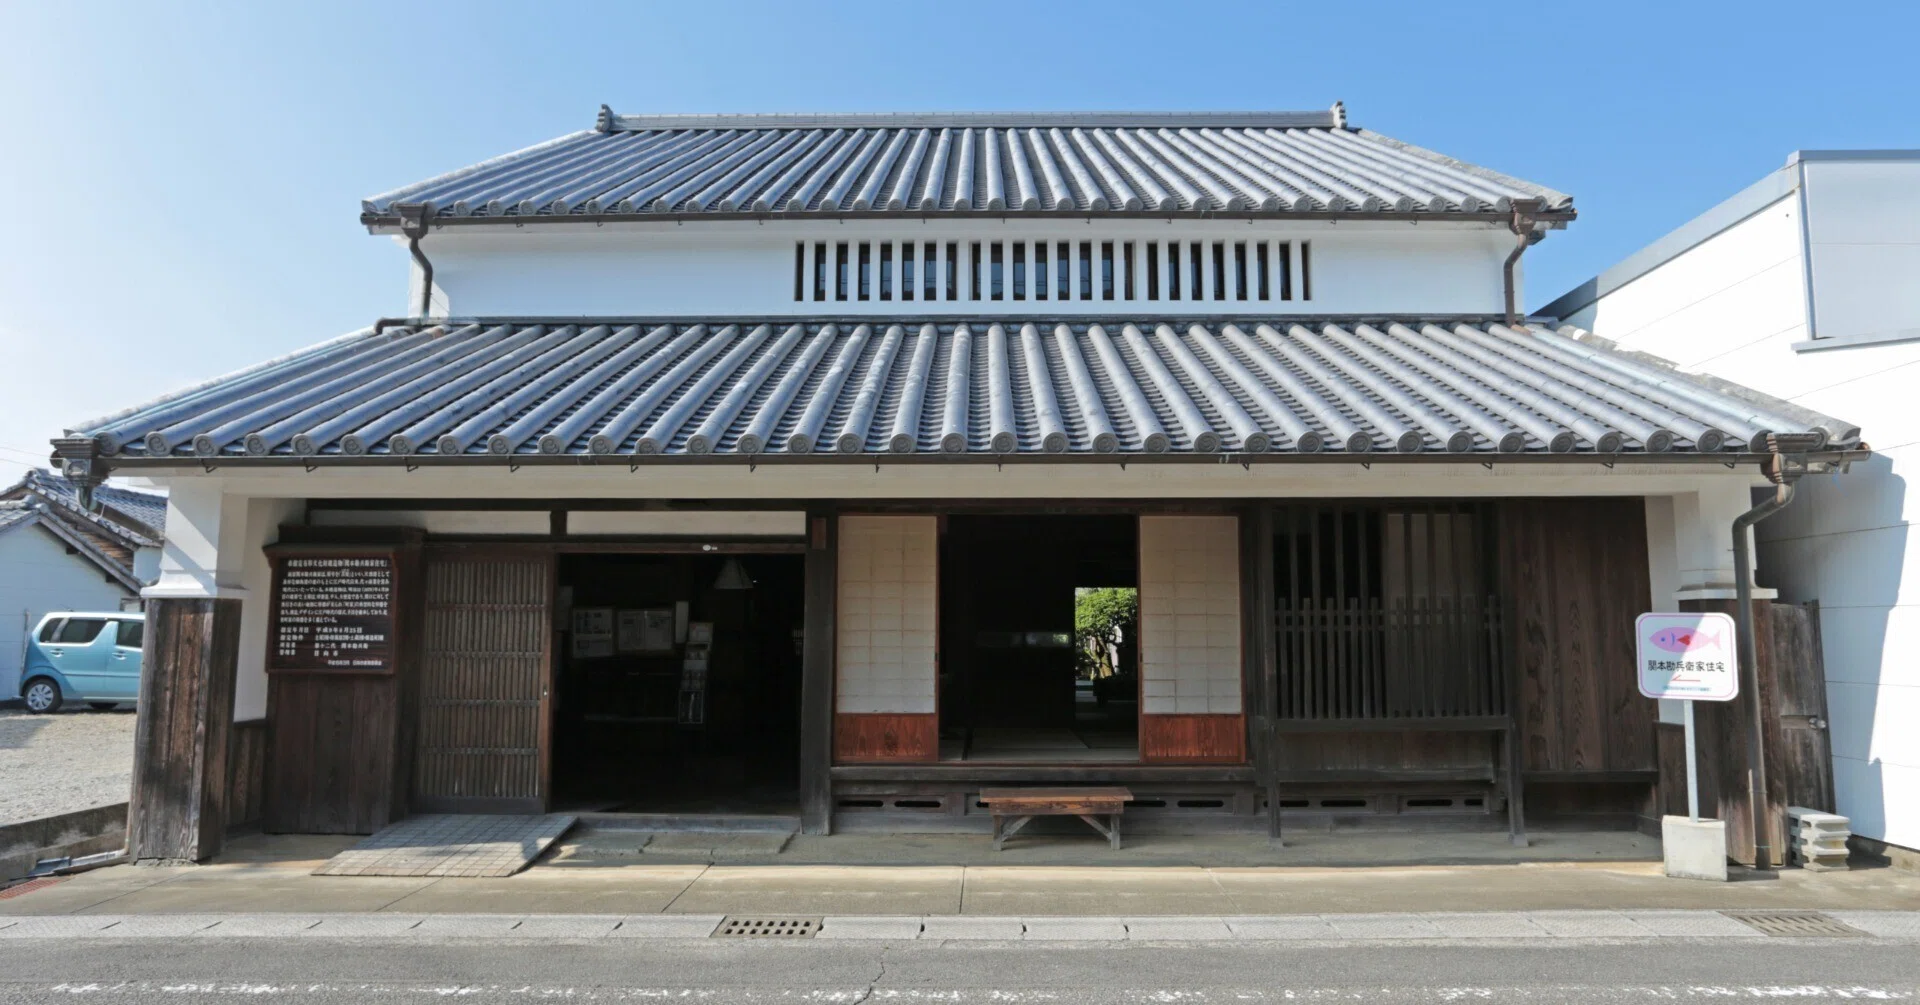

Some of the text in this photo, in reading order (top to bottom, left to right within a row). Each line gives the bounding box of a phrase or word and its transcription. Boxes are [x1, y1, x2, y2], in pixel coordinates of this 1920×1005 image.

[1647, 660, 1726, 673] 関本勘兵衛家住宅
